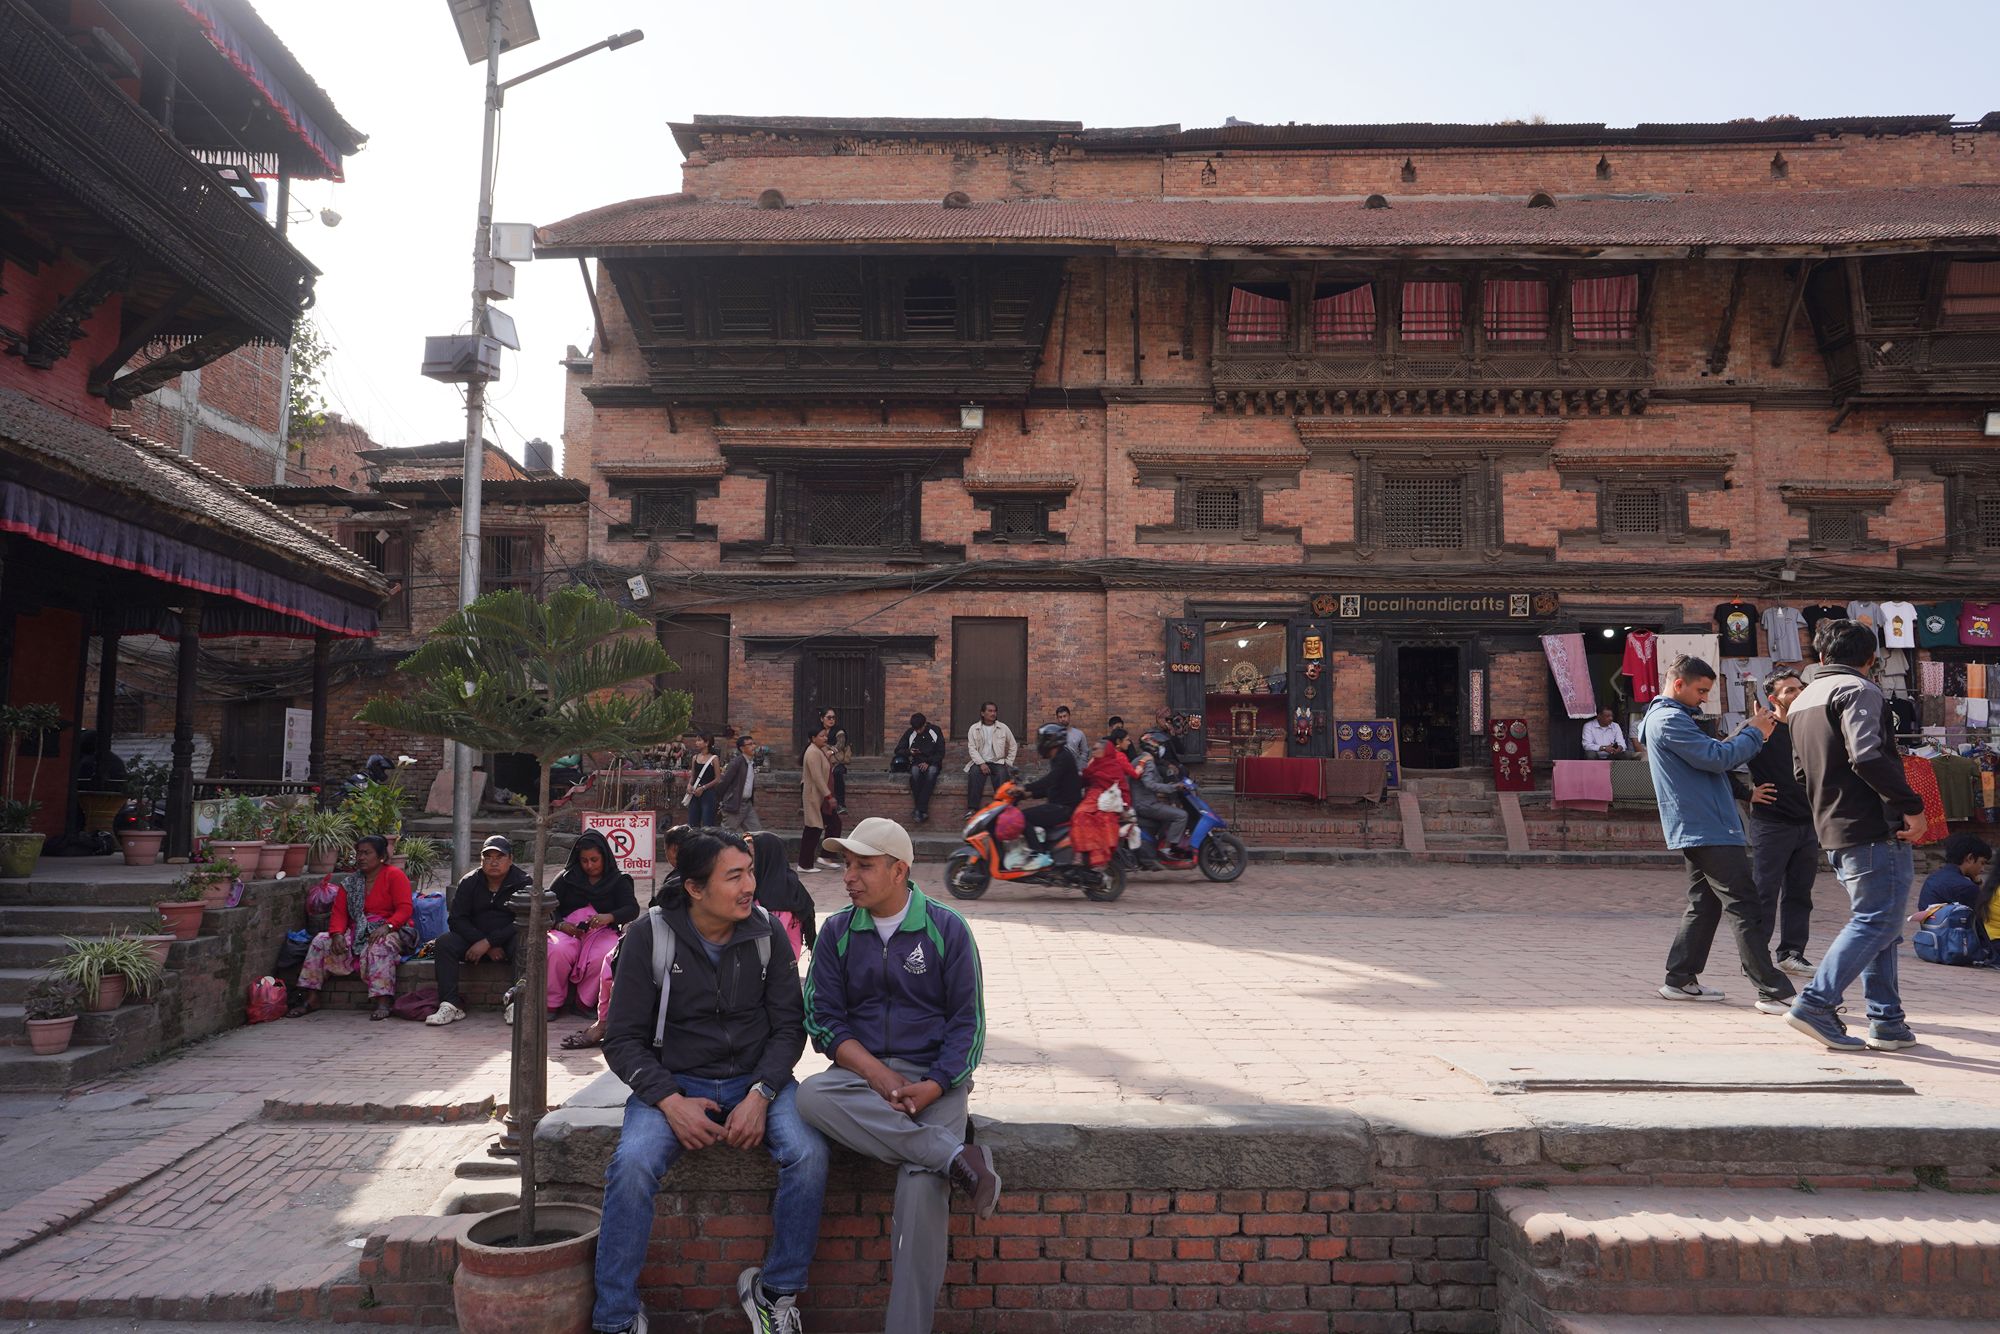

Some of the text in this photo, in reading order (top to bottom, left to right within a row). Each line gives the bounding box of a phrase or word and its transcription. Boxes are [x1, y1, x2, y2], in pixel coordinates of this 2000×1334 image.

[1363, 596, 1505, 612] localhandicrafts
[589, 814, 650, 829] सम्पदा क्षेत्र
[623, 857, 651, 869] निषेध
